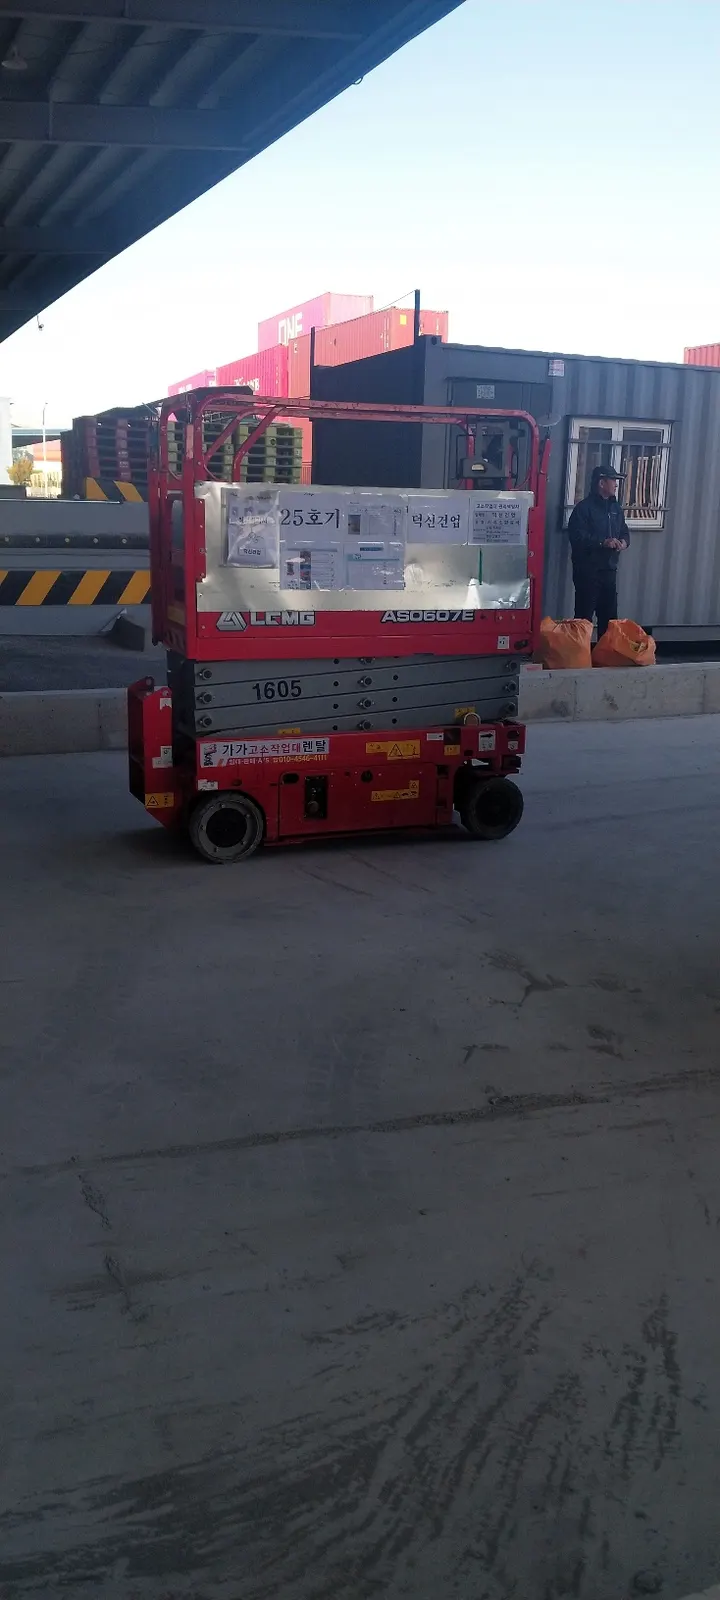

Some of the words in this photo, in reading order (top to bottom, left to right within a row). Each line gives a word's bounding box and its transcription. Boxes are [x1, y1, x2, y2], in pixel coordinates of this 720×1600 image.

[278, 312, 302, 346] ONE
[280, 508, 340, 528] 25호기
[412, 514, 461, 529] 덕신건업
[381, 610, 475, 623] AS0607E
[252, 680, 302, 700] 1605
